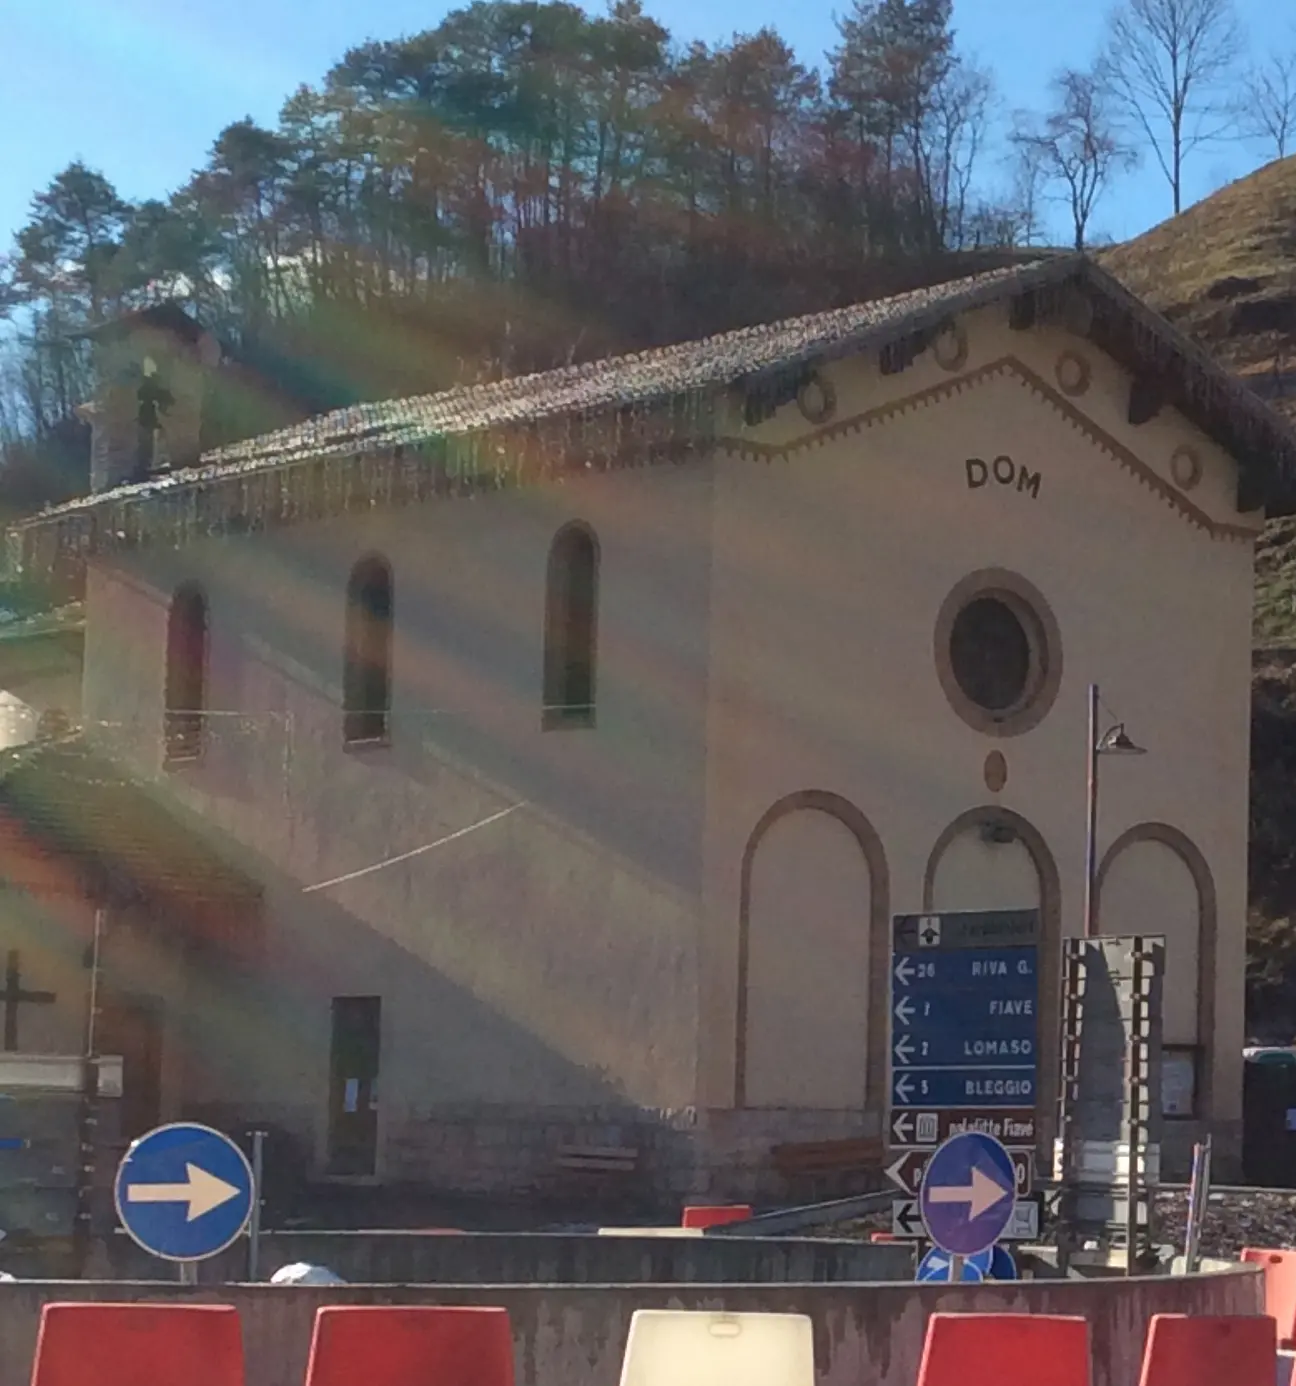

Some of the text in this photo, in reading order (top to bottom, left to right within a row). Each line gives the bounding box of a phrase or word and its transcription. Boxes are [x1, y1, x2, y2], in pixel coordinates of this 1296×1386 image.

[965, 455, 1042, 500] DOM
[917, 963, 935, 978] 26
[972, 961, 1007, 976] RIVA
[964, 1039, 1032, 1055] LOMASO
[965, 1079, 1032, 1095] BLEGGIO
